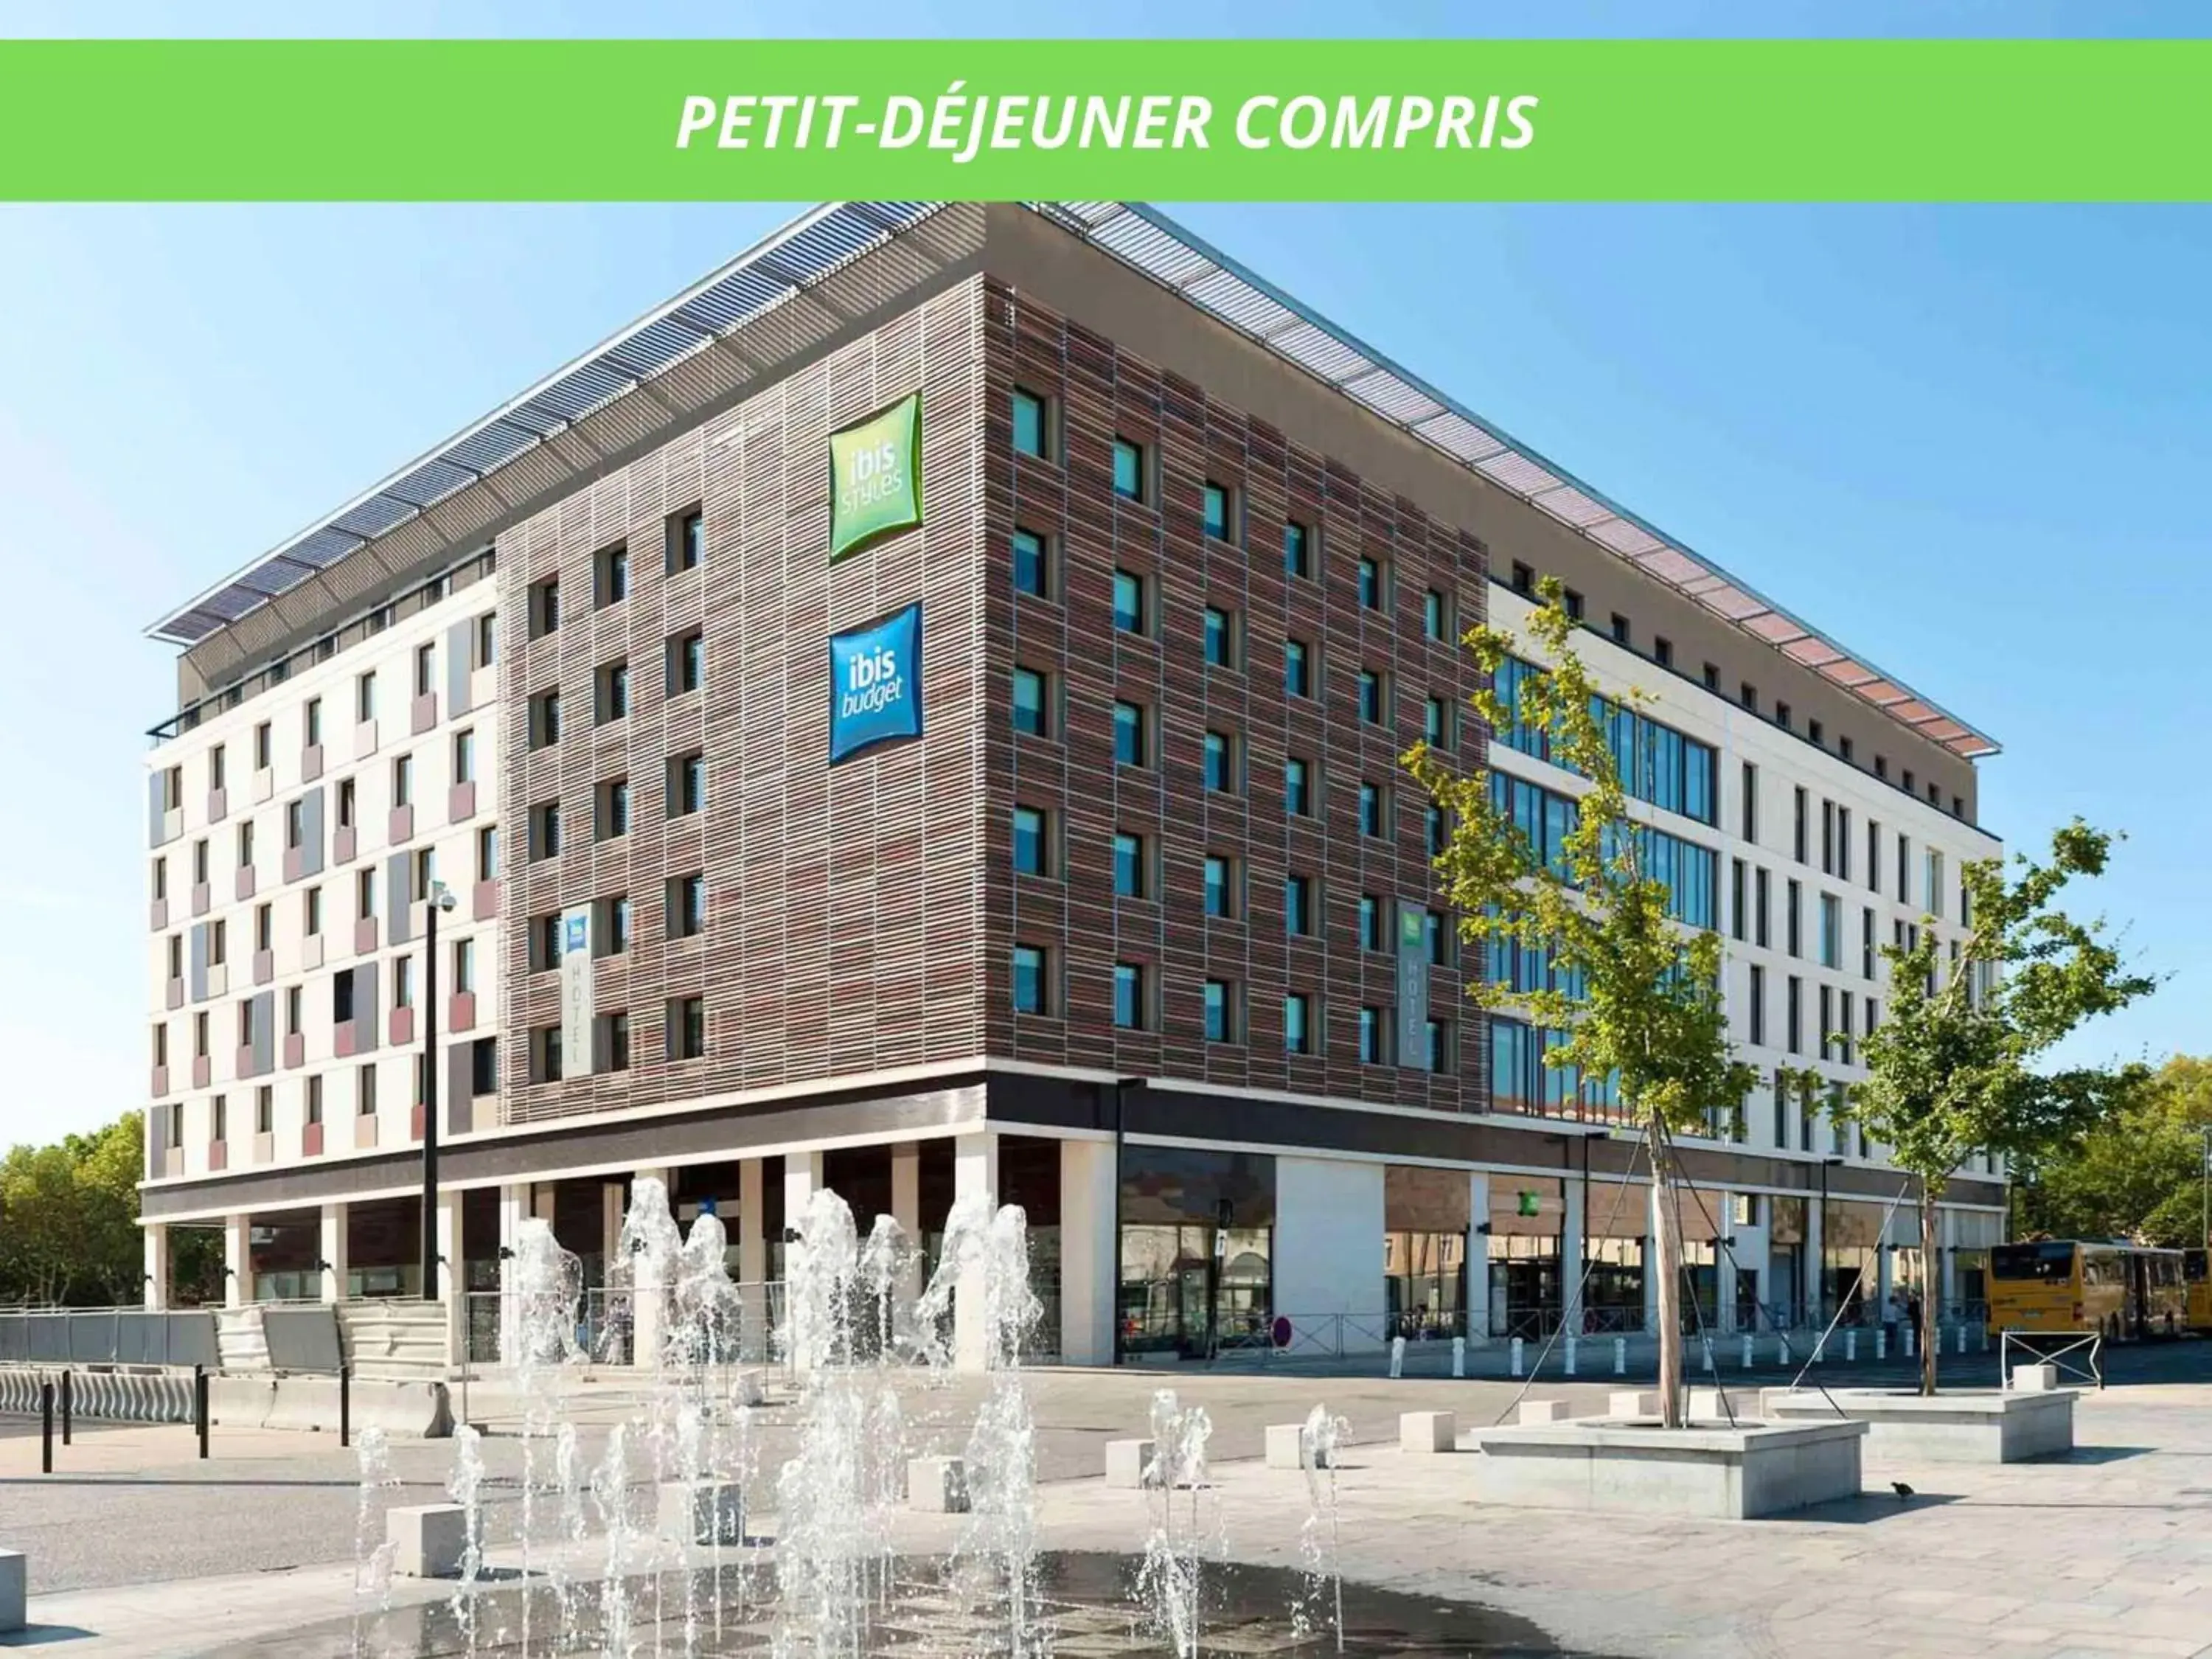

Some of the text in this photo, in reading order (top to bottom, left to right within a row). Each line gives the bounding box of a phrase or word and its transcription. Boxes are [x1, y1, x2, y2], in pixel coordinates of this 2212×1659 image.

[850, 439, 896, 486] ibis
[849, 645, 896, 692] ibis
[842, 675, 903, 719] budget
[571, 964, 582, 1064] HOTEL
[1407, 959, 1419, 1057] HOTEL
